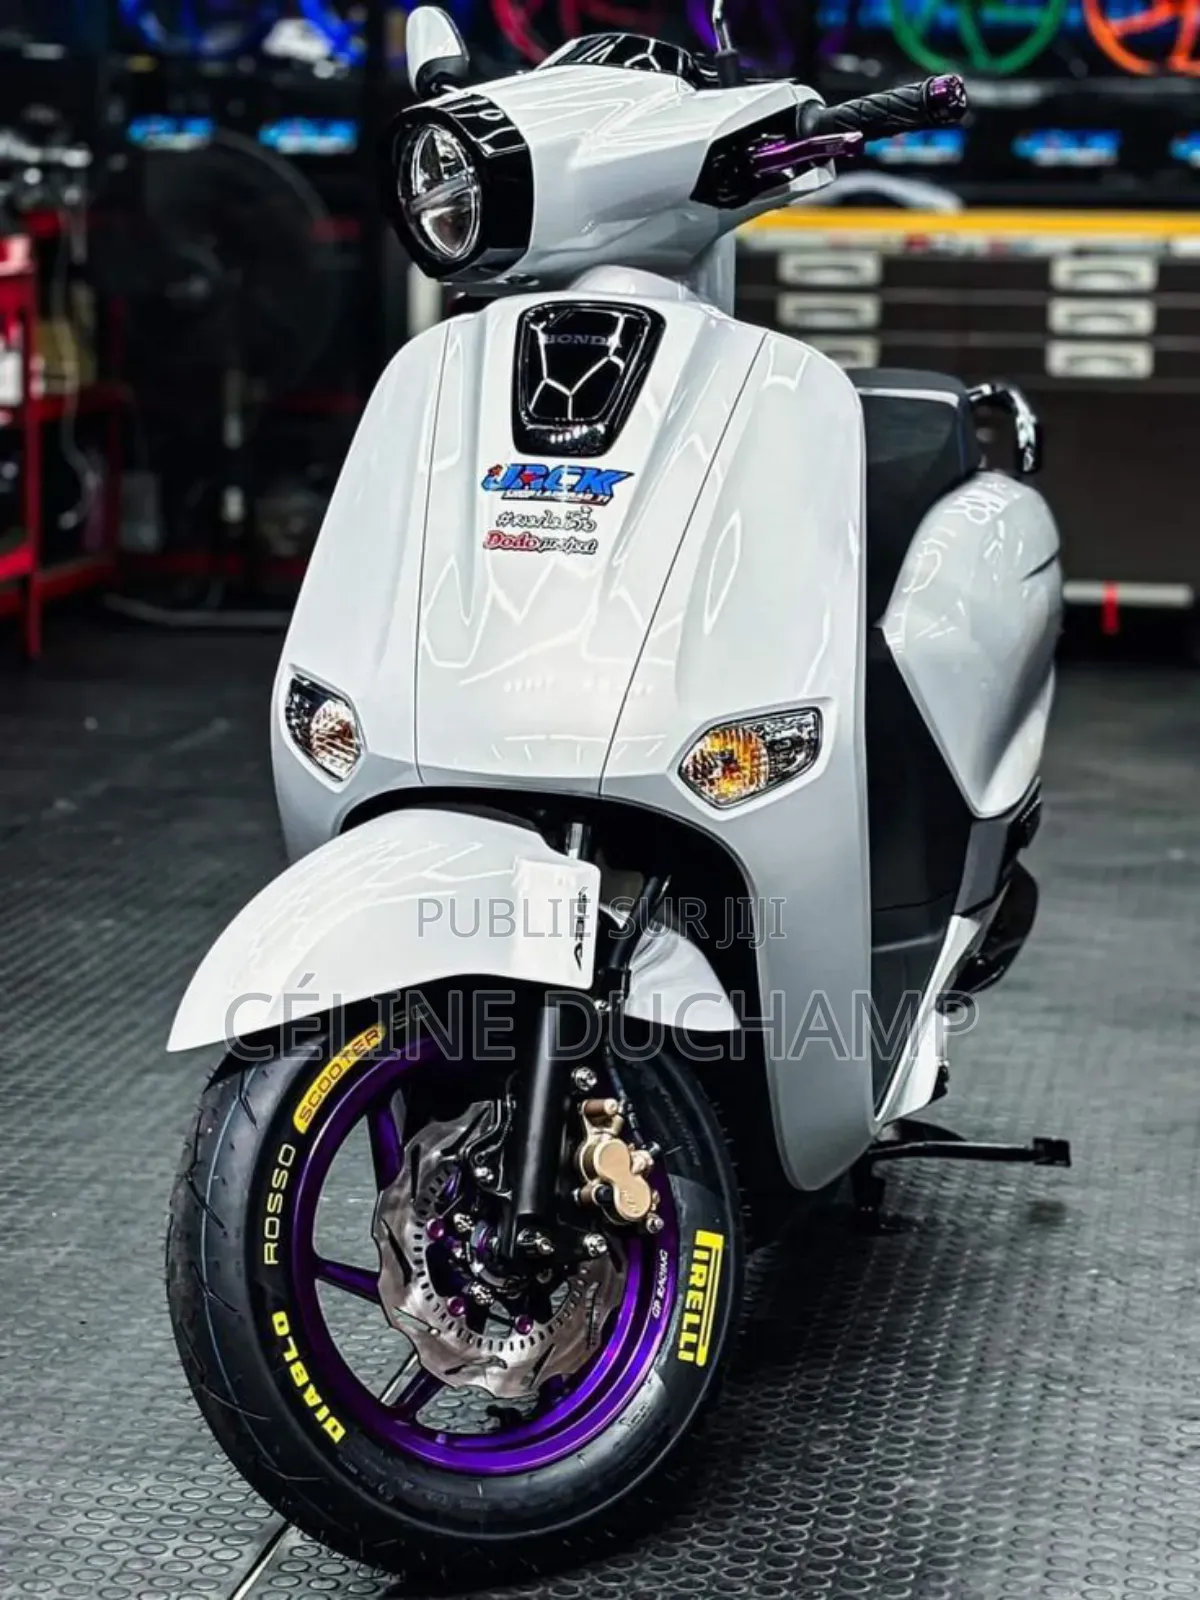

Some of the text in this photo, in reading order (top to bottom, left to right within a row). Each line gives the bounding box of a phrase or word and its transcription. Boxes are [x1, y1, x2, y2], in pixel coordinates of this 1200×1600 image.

[299, 1028, 380, 1124] SCOOTER
[264, 1143, 296, 1265] ROSSO
[678, 1229, 724, 1367] PIRELLI
[272, 1310, 346, 1444] DIABLO
